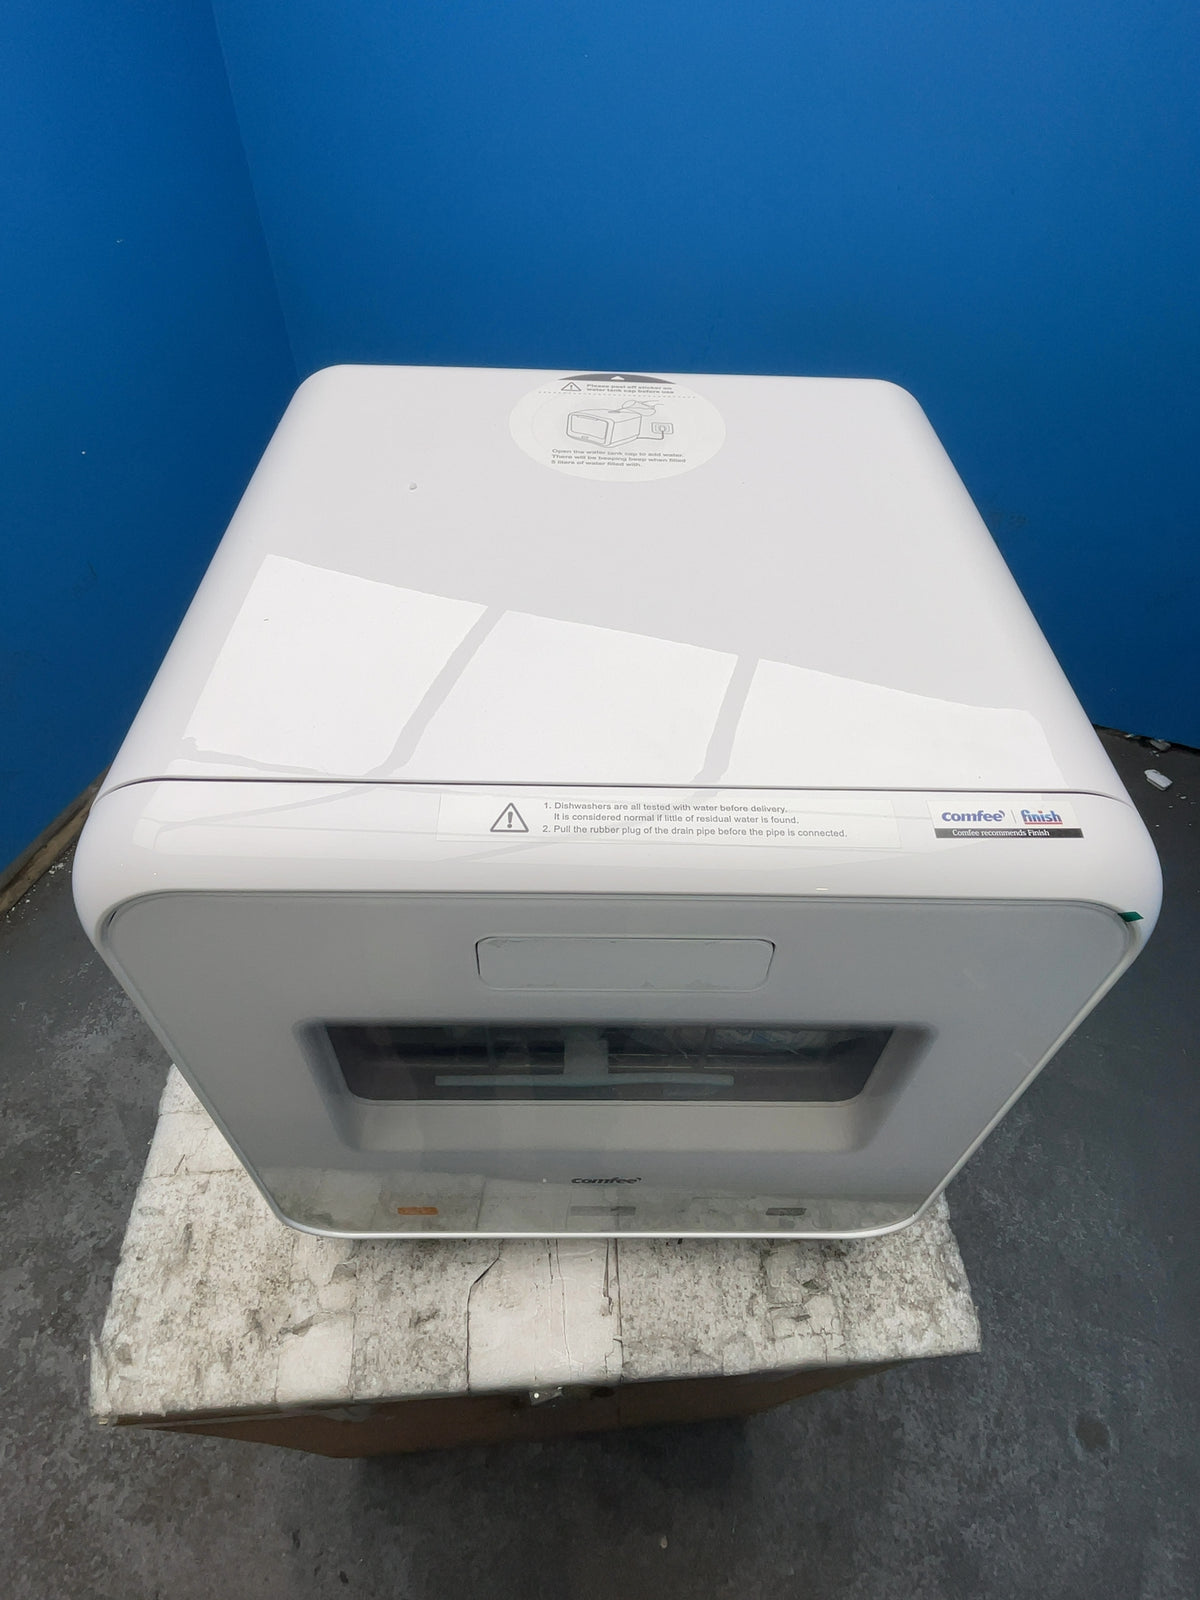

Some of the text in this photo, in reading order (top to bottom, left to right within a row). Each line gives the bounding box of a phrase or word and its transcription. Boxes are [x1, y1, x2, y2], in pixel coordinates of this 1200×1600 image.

[751, 805, 788, 814] delivery.
[771, 816, 800, 824] found.
[1020, 809, 1062, 823] finish
[622, 827, 641, 836] plug
[696, 828, 716, 836] pipe
[718, 828, 747, 836] before
[766, 829, 786, 838] pipe
[788, 829, 796, 837] is
[798, 830, 848, 838] connected.
